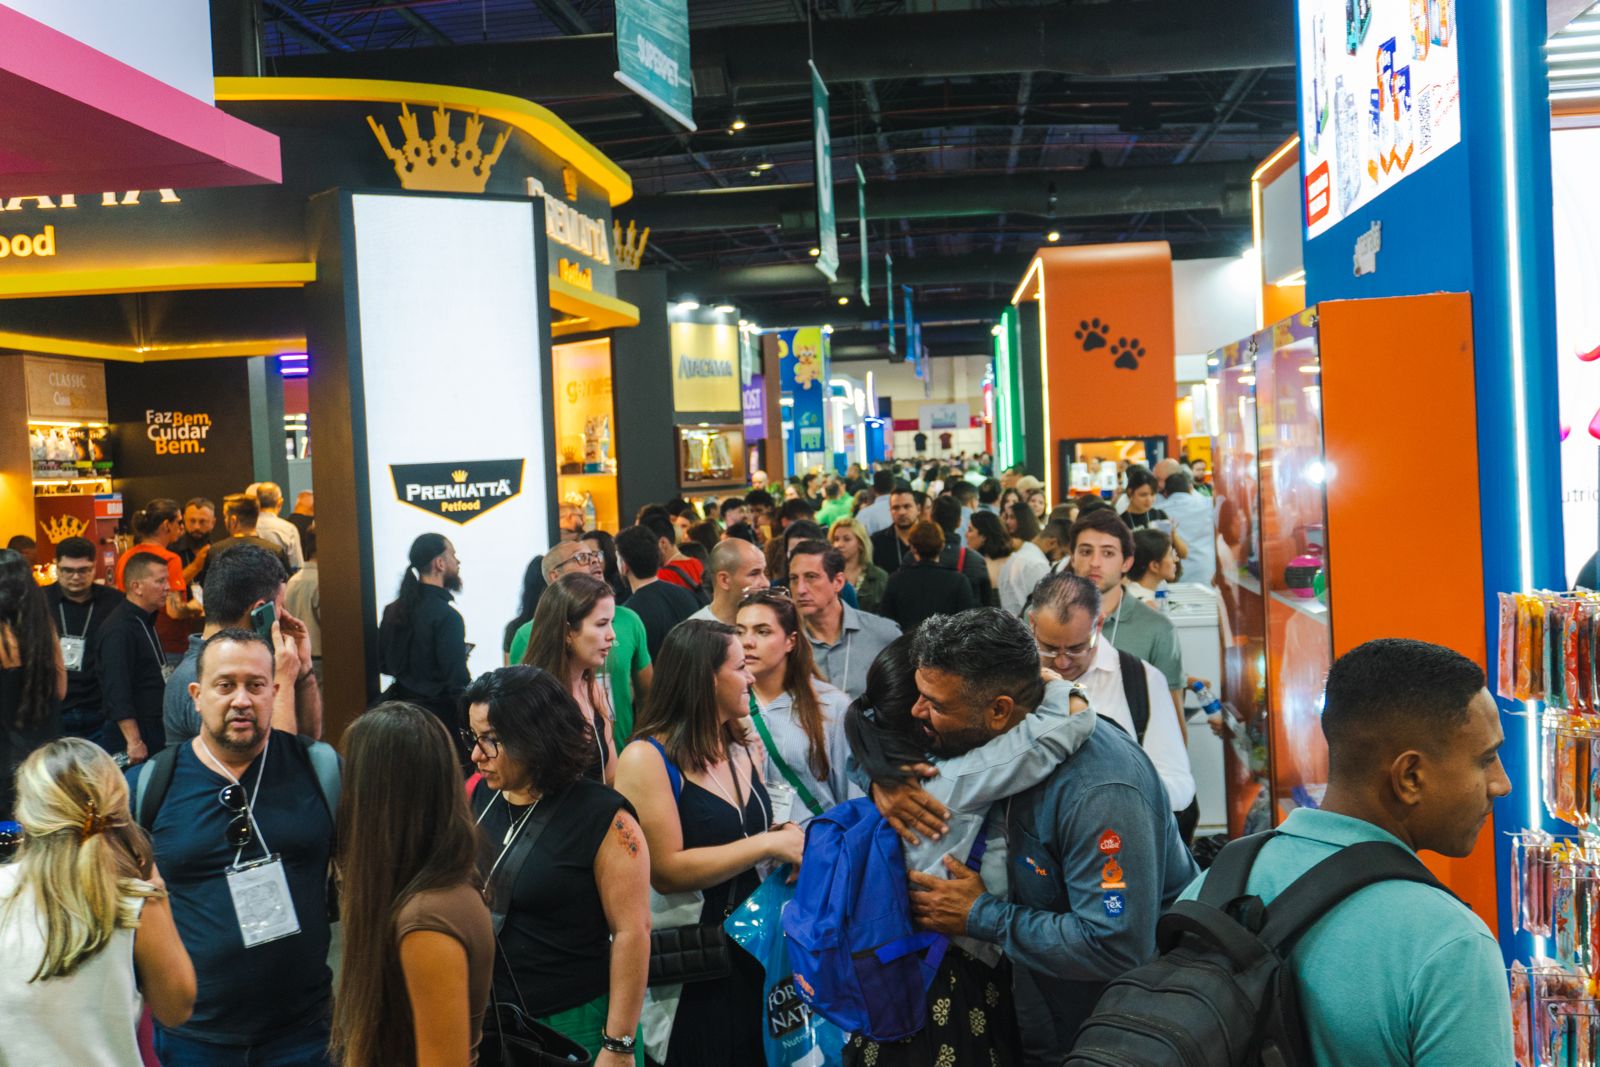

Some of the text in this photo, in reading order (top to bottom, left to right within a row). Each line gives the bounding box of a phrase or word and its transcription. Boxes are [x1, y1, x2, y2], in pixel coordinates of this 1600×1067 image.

[146, 409, 212, 427] Faz Bem,
[147, 422, 210, 442] Cuidar
[155, 436, 206, 455] Bem.
[441, 500, 481, 512] Petfood
